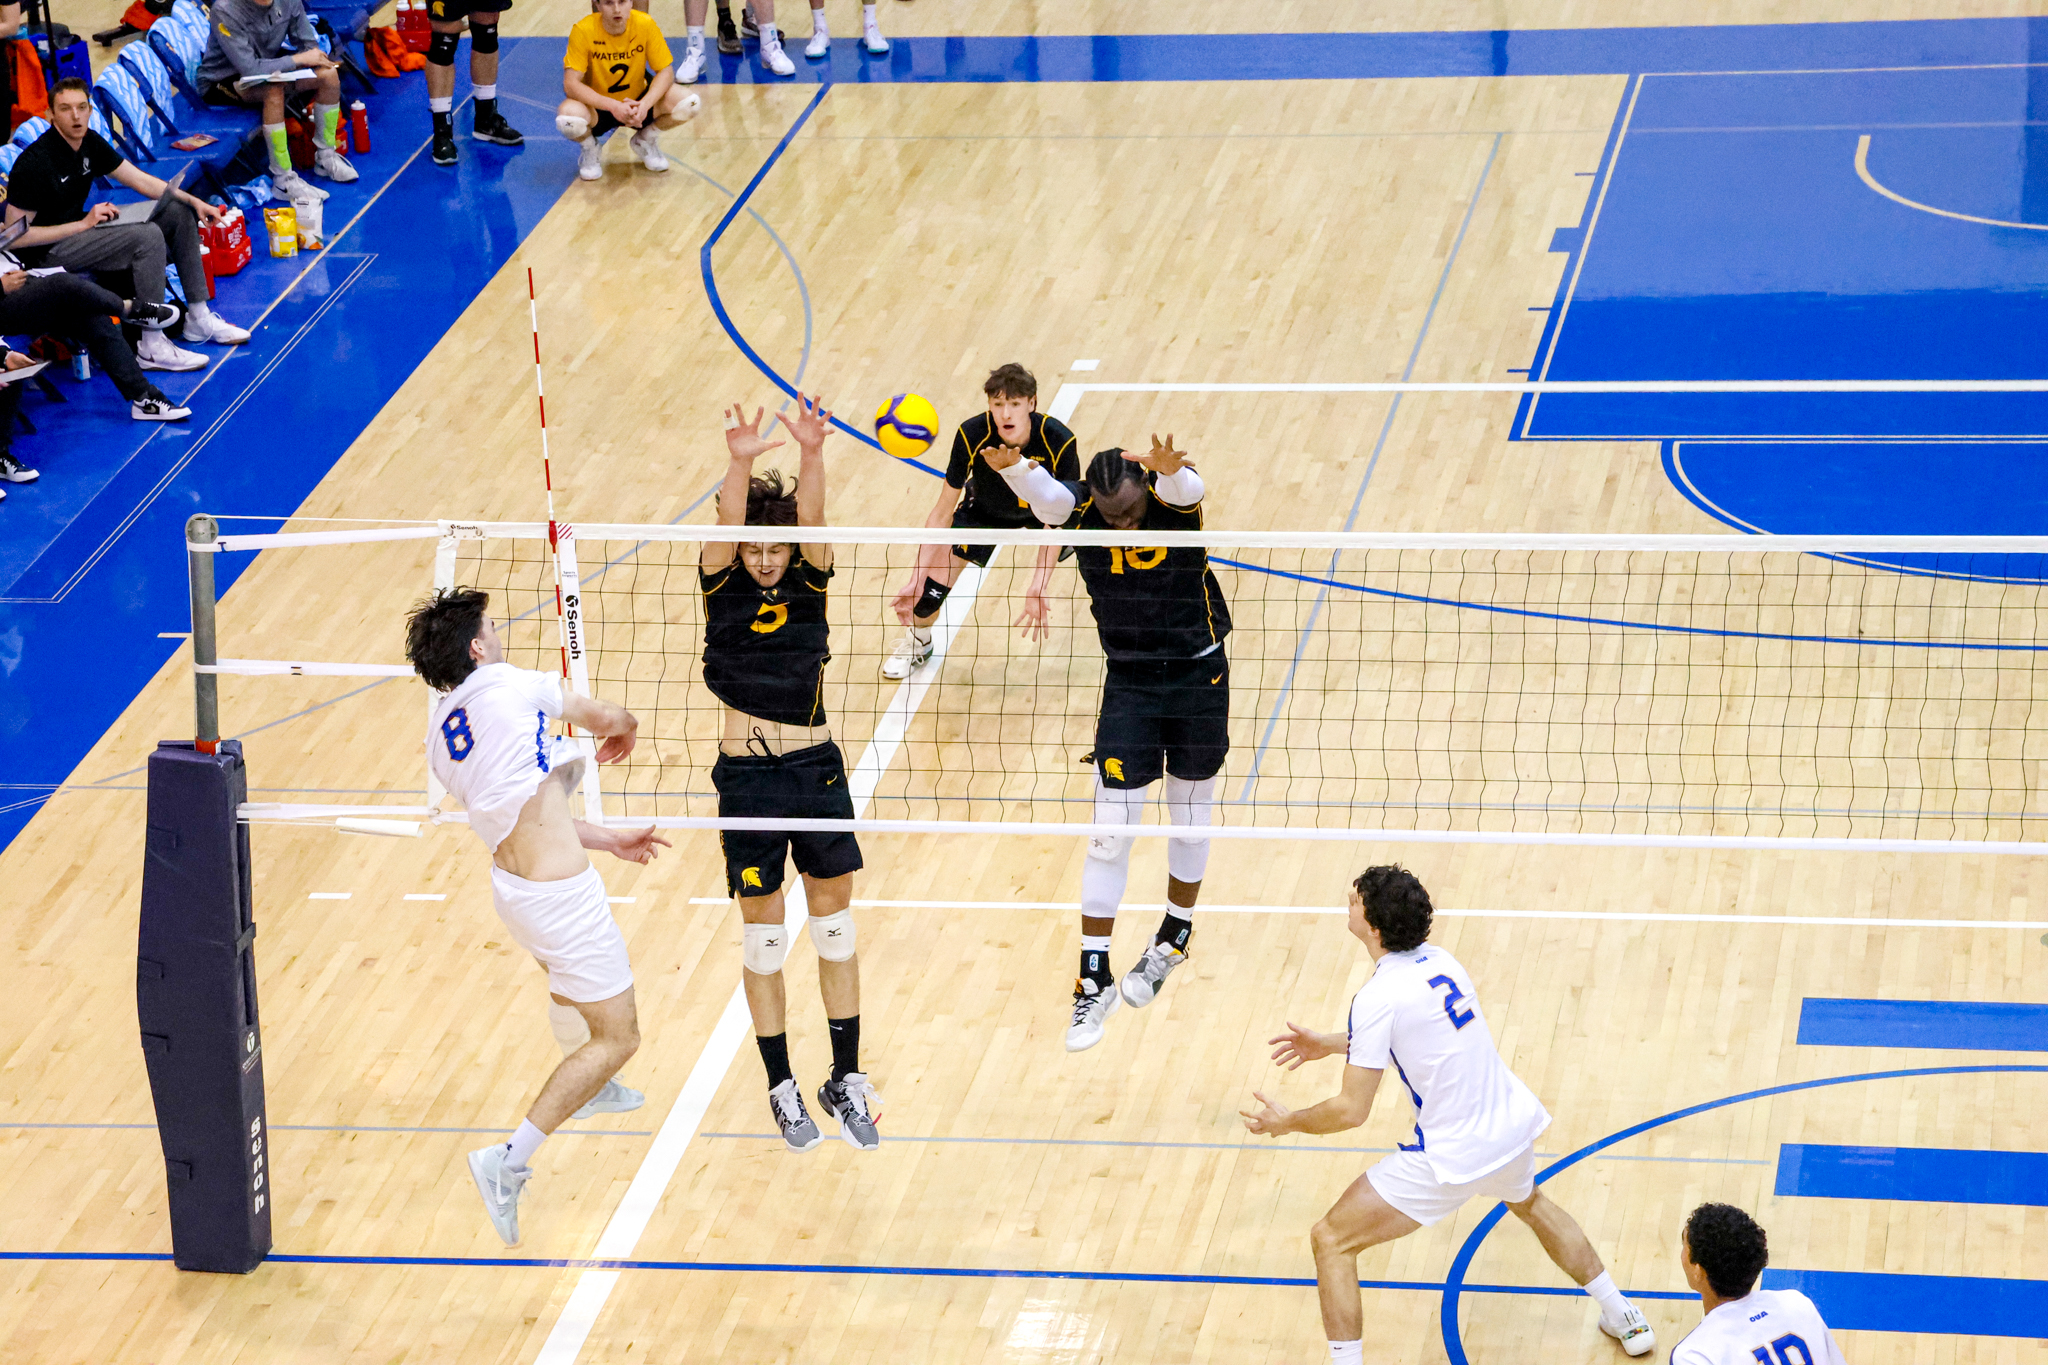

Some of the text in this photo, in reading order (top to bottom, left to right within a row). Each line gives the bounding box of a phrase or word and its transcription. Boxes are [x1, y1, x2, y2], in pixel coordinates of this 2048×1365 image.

[592, 44, 644, 61] WATERLOO
[608, 63, 630, 93] 2
[567, 609, 582, 660] Senoh
[441, 706, 475, 763] 8
[1425, 973, 1476, 1032] 2
[1749, 1311, 1768, 1322] OUA
